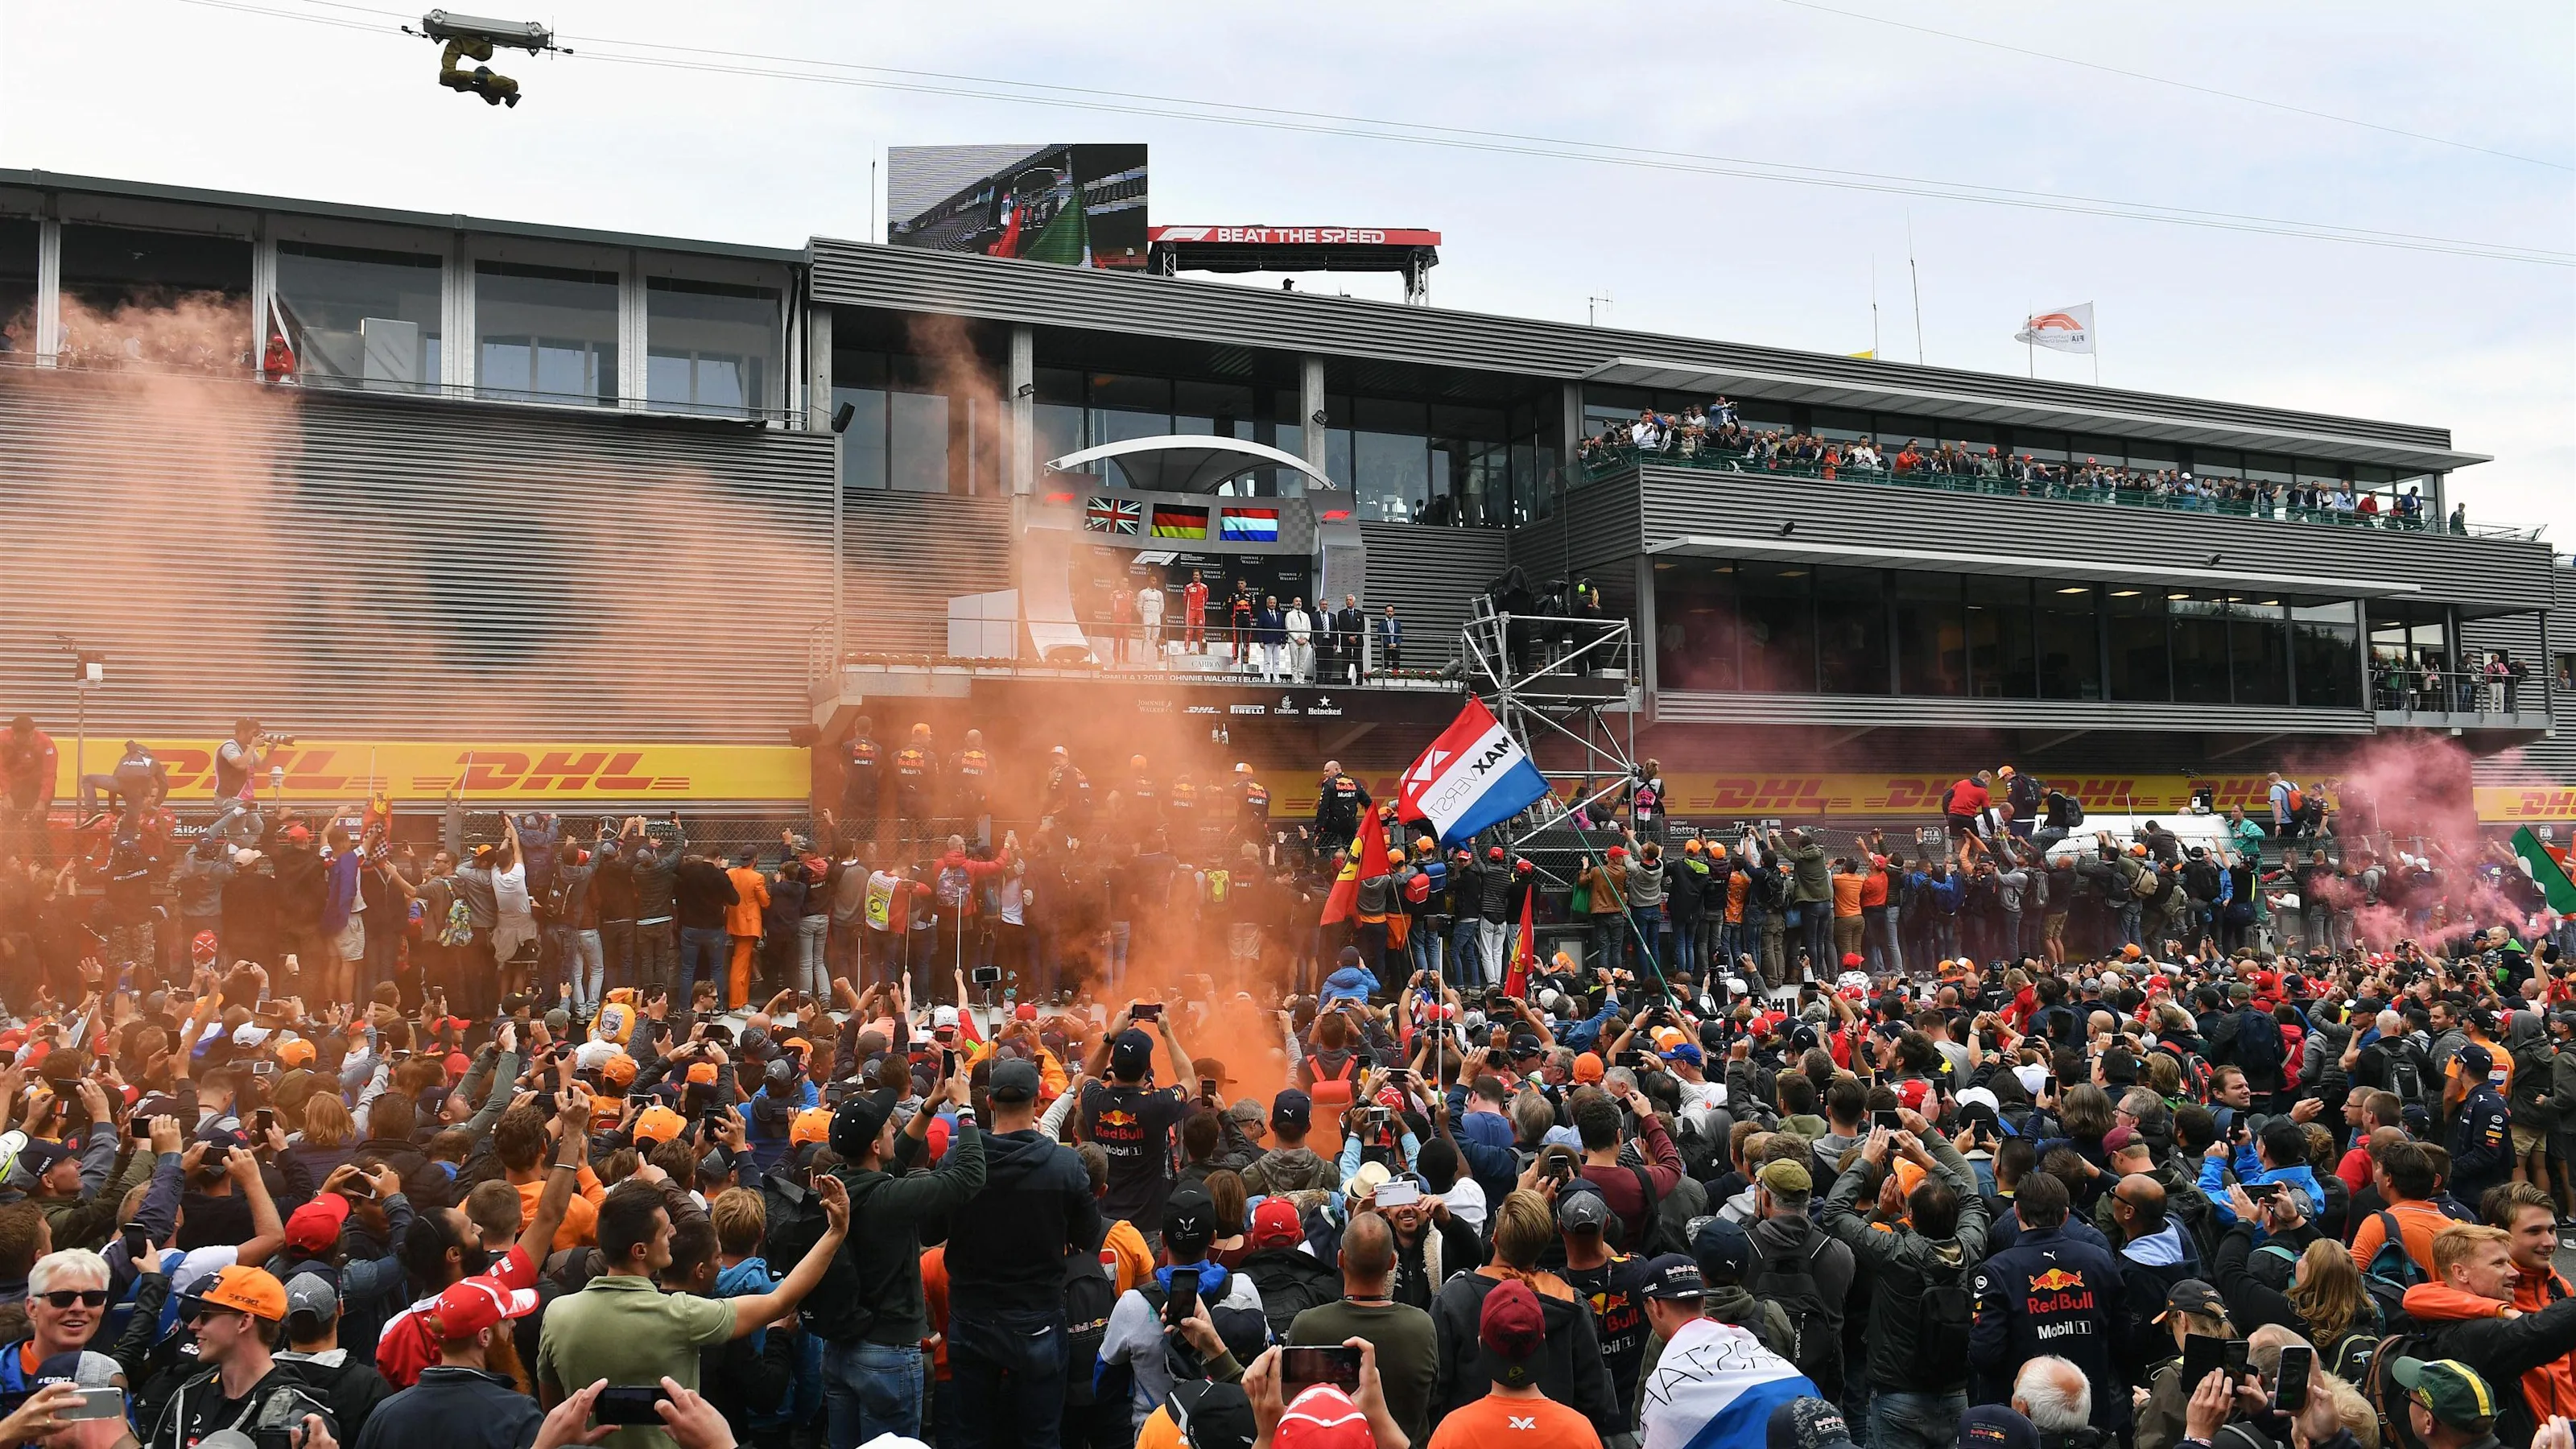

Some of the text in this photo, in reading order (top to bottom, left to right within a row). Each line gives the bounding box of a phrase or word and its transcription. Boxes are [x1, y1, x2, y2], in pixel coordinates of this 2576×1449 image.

[1217, 228, 1270, 242] BEAT
[1274, 229, 1316, 243] THE
[1321, 229, 1386, 244] SPEED
[1230, 705, 1265, 715] PIRELLI
[1308, 708, 1342, 716] Heineken
[453, 753, 654, 791] DHL
[1712, 779, 1829, 808] DHL
[2540, 828, 2552, 837] FIA
[114, 869, 148, 881] PETRONAS
[1096, 1125, 1144, 1140] Red Bull
[1103, 1144, 1129, 1156] Mobil
[234, 1294, 259, 1307] exact
[2027, 1291, 2093, 1314] Red Bull
[1606, 1307, 1639, 1332] Bull
[2037, 1321, 2074, 1340] Mobil
[1601, 1340, 1620, 1354] bil
[44, 1376, 72, 1385] exact
